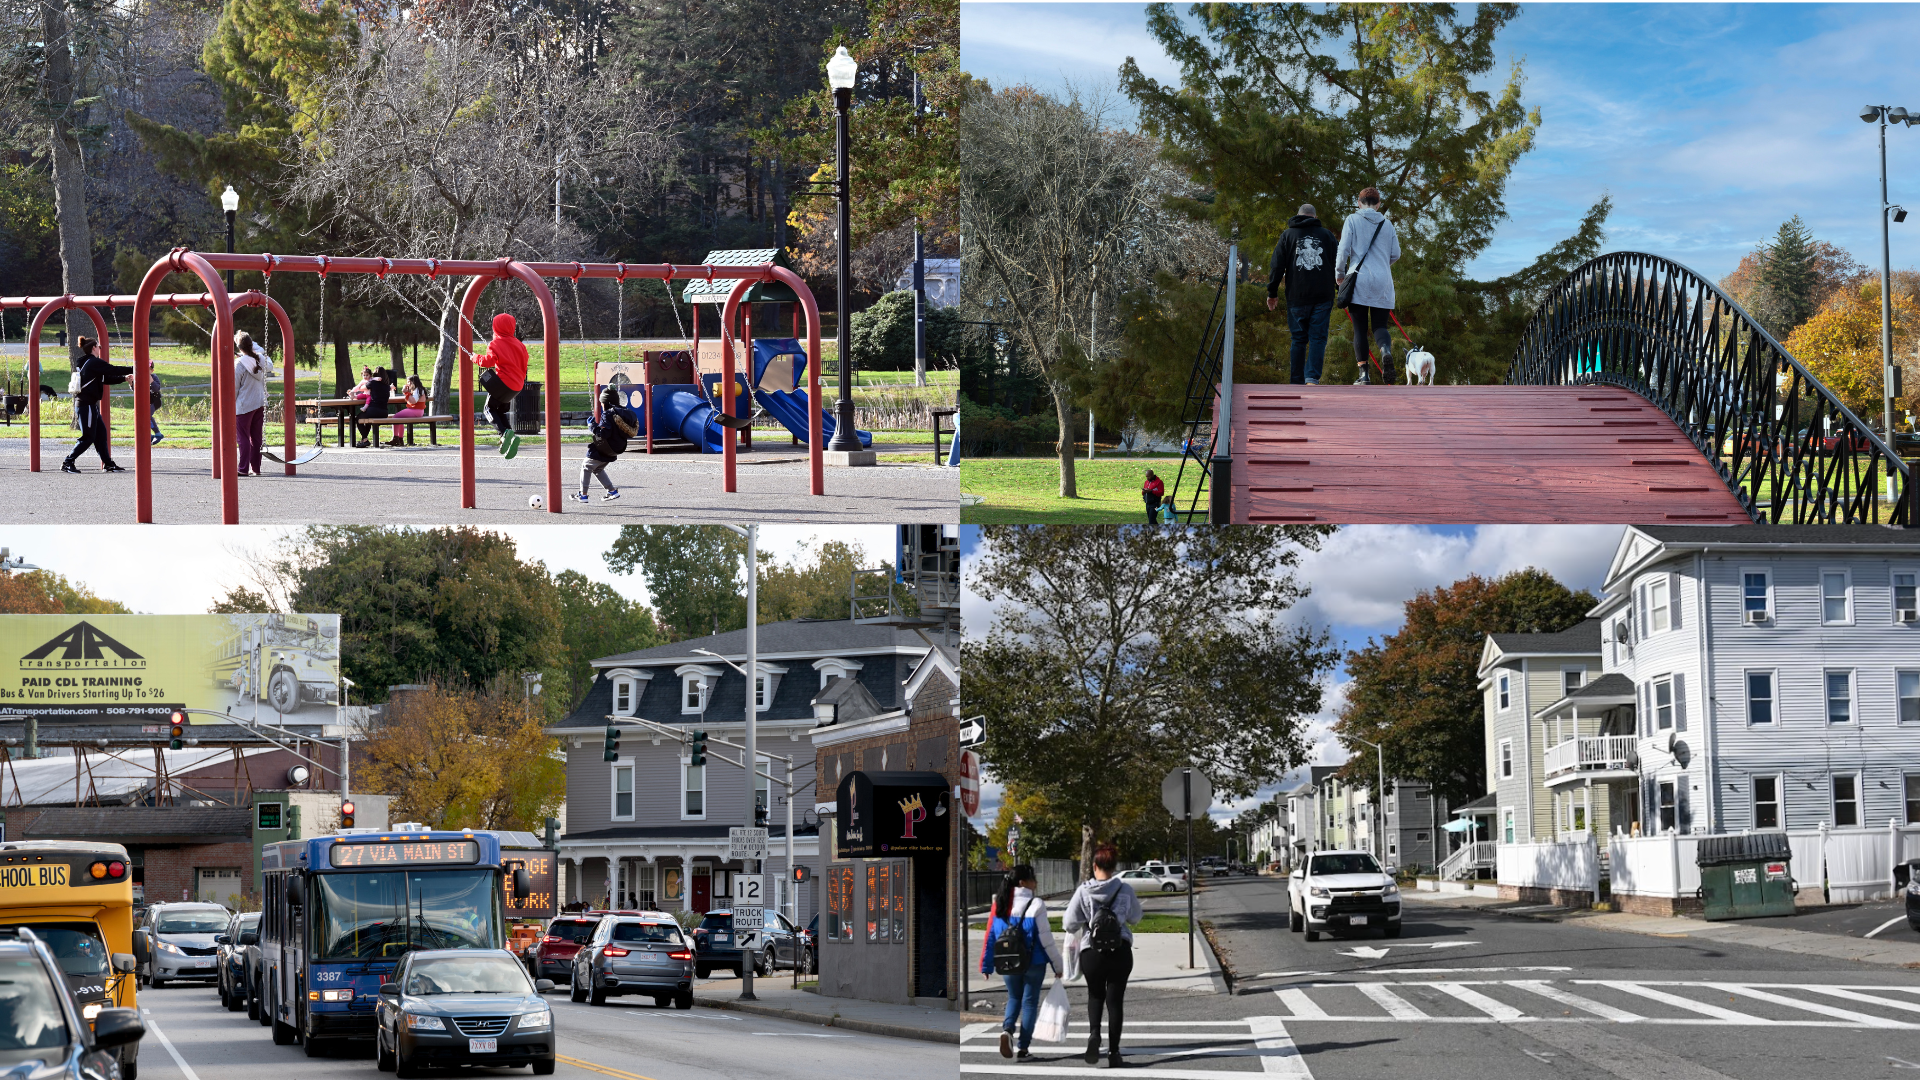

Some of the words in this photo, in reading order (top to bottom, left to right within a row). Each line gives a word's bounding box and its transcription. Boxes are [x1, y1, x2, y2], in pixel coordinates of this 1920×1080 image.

[19, 659, 147, 670] transportation
[22, 677, 51, 687] PAID
[55, 677, 78, 687] CDL
[82, 677, 143, 687] TRAINING
[0, 688, 15, 699] Bus
[18, 689, 25, 698] &
[28, 688, 45, 699] Van
[47, 688, 81, 699] Drivers
[82, 688, 120, 701] Starting
[122, 688, 133, 700] Up
[136, 688, 147, 698] To
[149, 687, 165, 698] $26
[0, 707, 98, 716] ATransportation.com
[106, 707, 171, 715] 508-791-9100
[746, 836, 756, 844] OVER
[340, 846, 364, 866] 27
[369, 845, 398, 861] VIA
[403, 844, 442, 860] MAIN
[447, 843, 467, 859] ST
[0, 867, 36, 888] HOOL
[39, 866, 66, 886] BUS
[738, 881, 760, 898] 12
[735, 908, 762, 917] TRUCK
[735, 918, 762, 926] ROUTE
[317, 971, 341, 981] 3387
[73, 985, 104, 996] -918
